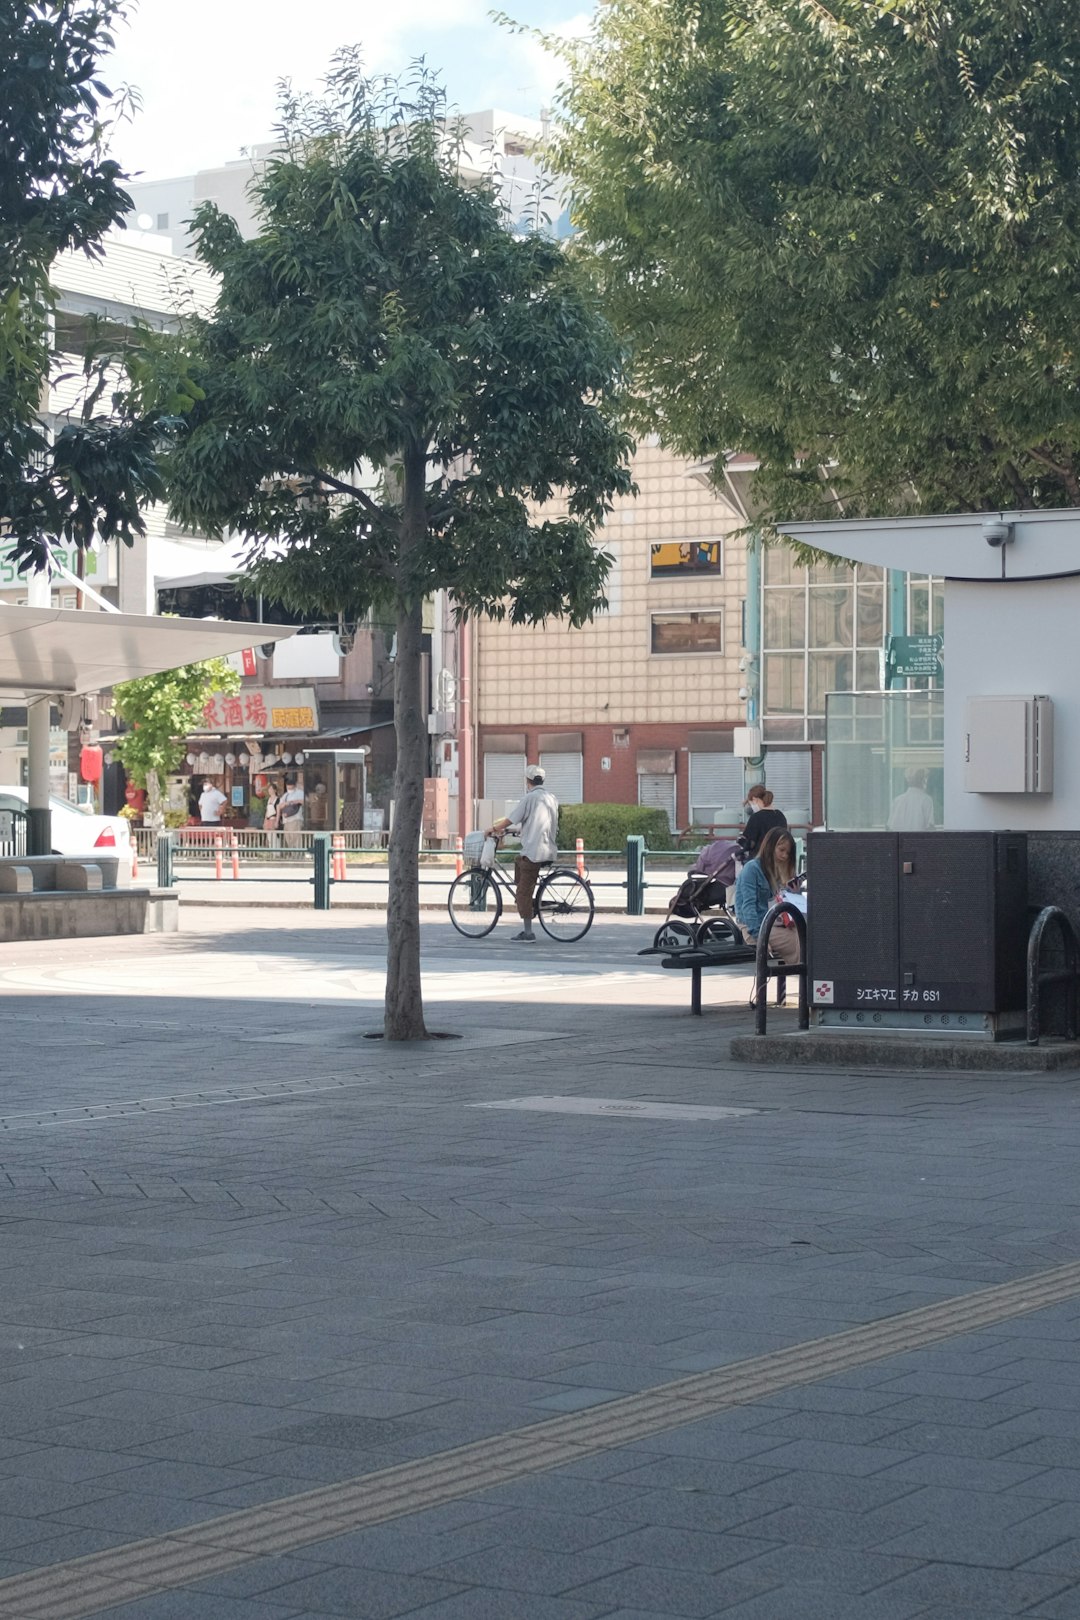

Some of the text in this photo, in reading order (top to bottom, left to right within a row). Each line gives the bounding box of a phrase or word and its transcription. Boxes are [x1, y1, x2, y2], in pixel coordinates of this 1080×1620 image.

[184, 693, 267, 731] 衆酒場
[857, 988, 940, 1001] シエキマエ チカ 6S1
